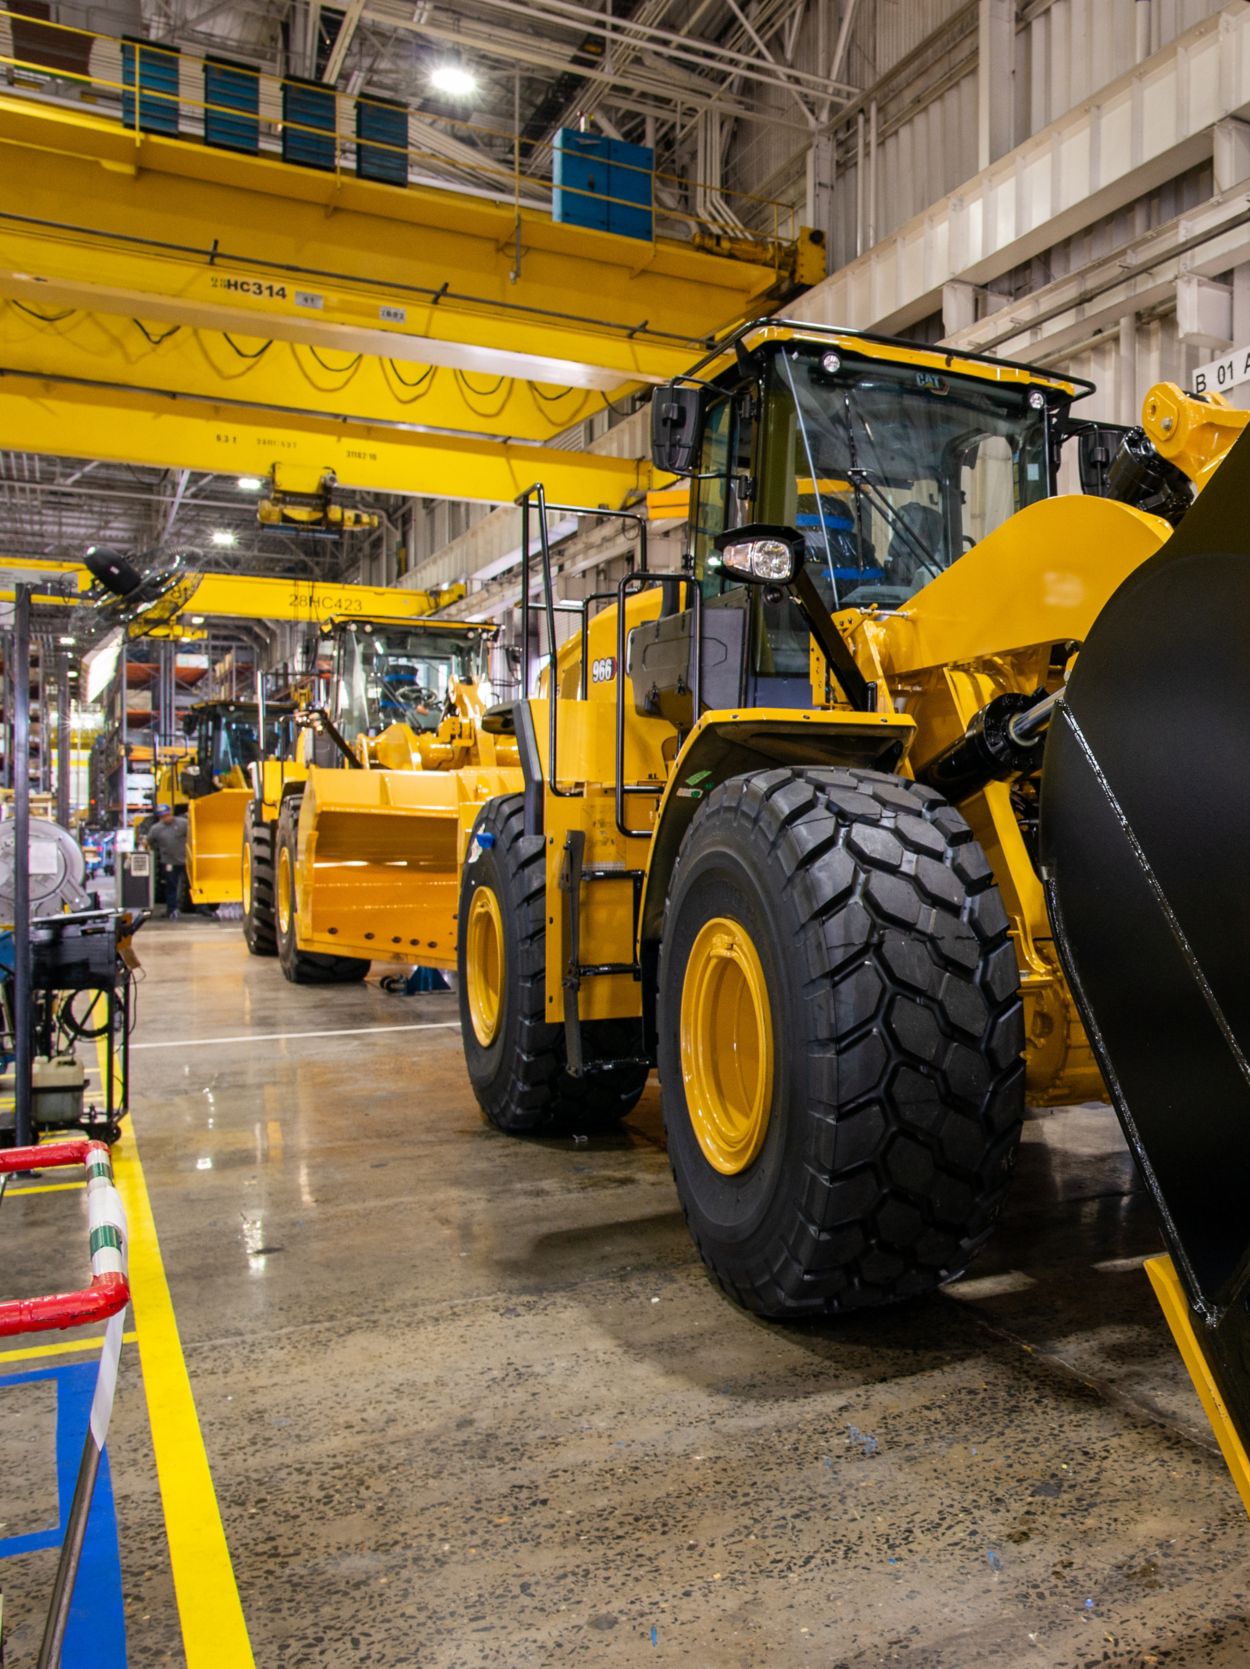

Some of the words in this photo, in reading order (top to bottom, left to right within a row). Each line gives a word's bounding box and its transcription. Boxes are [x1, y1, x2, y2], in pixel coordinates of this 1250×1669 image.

[915, 372, 941, 389] CAT
[1195, 373, 1207, 393] B
[1217, 360, 1234, 385] 01
[288, 593, 363, 612] 28HC423
[592, 657, 613, 683] 966
